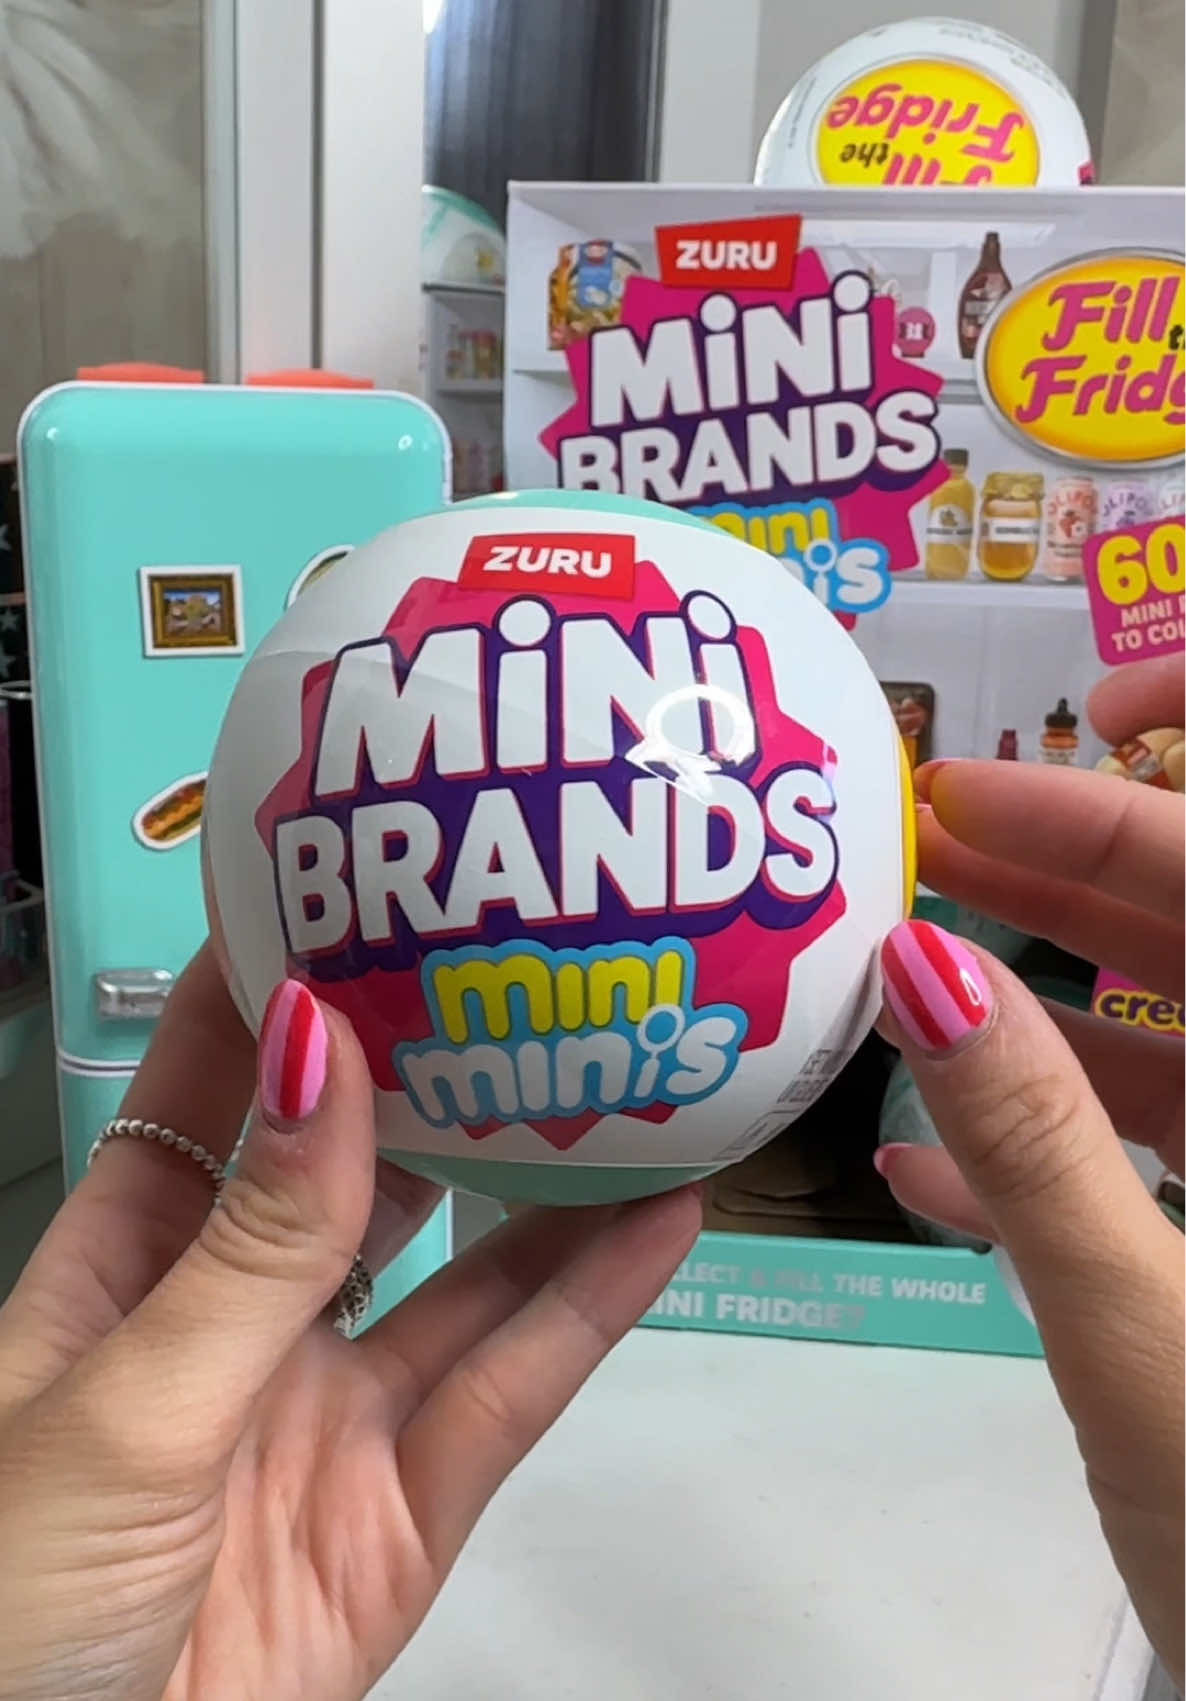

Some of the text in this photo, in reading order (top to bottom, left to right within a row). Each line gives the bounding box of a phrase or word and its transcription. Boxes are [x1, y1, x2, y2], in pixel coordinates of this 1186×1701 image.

[826, 83, 1025, 162] Fridge
[839, 143, 889, 168] the
[675, 240, 778, 271] ZURU
[1040, 276, 1181, 352] Fill
[559, 390, 939, 501] BRANDS
[482, 545, 612, 577] ZURU
[1097, 523, 1185, 606] 60
[1112, 628, 1143, 652] TO
[1120, 598, 1173, 628] MINI
[276, 767, 839, 955] BRANDS
[431, 950, 684, 1045] mini
[1100, 995, 1185, 1027] cre
[400, 1003, 736, 1122] minis
[833, 1274, 883, 1297] THE
[891, 1278, 987, 1304] WHOLE
